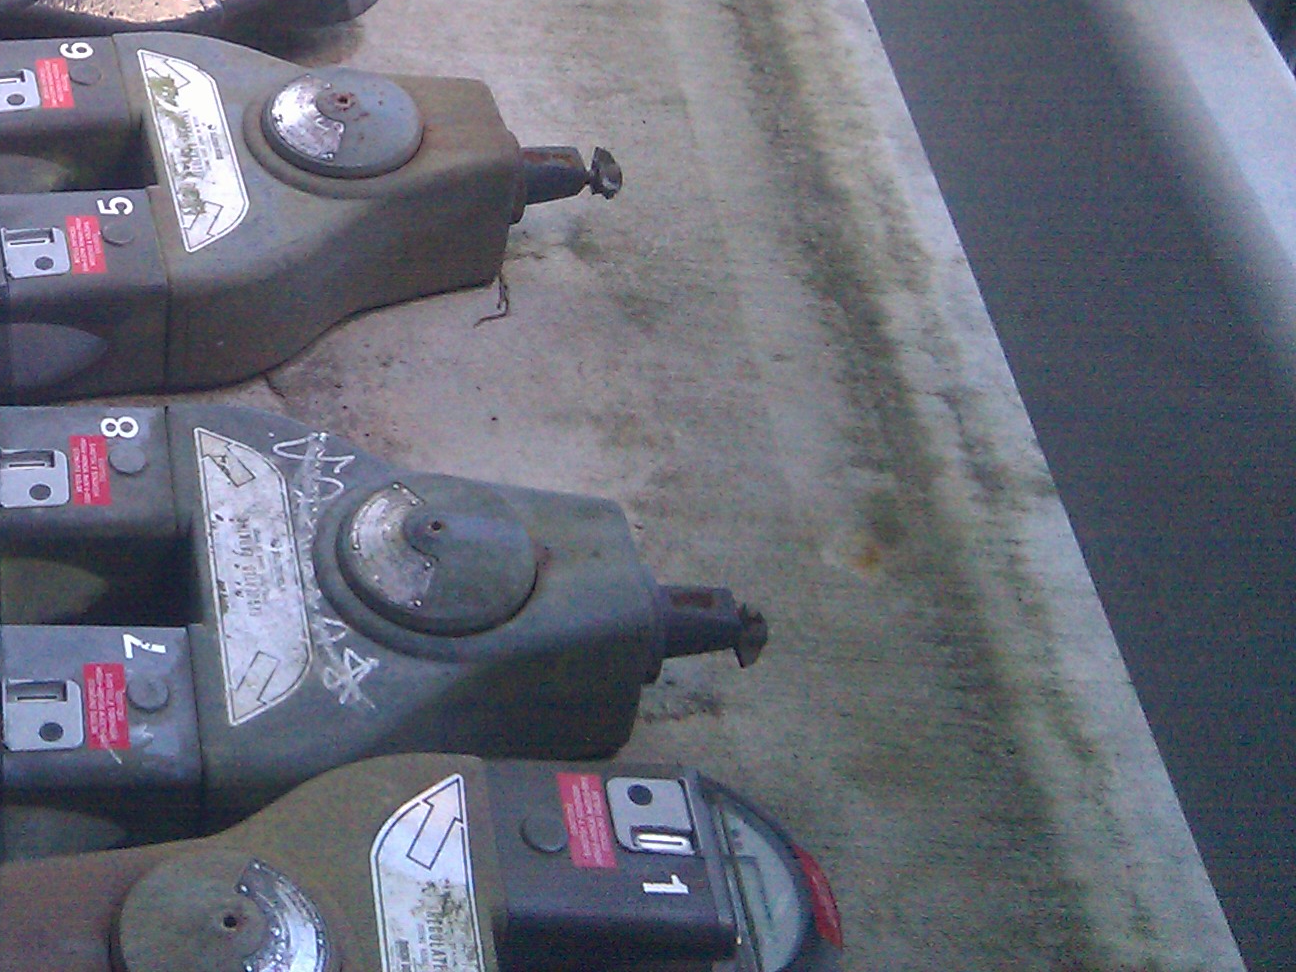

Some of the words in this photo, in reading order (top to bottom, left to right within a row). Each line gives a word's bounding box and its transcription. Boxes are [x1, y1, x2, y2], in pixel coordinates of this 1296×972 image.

[60, 42, 93, 59] 6
[97, 196, 133, 215] 5
[101, 417, 138, 438] 8
[123, 634, 165, 659] 7
[643, 875, 689, 894] 1
